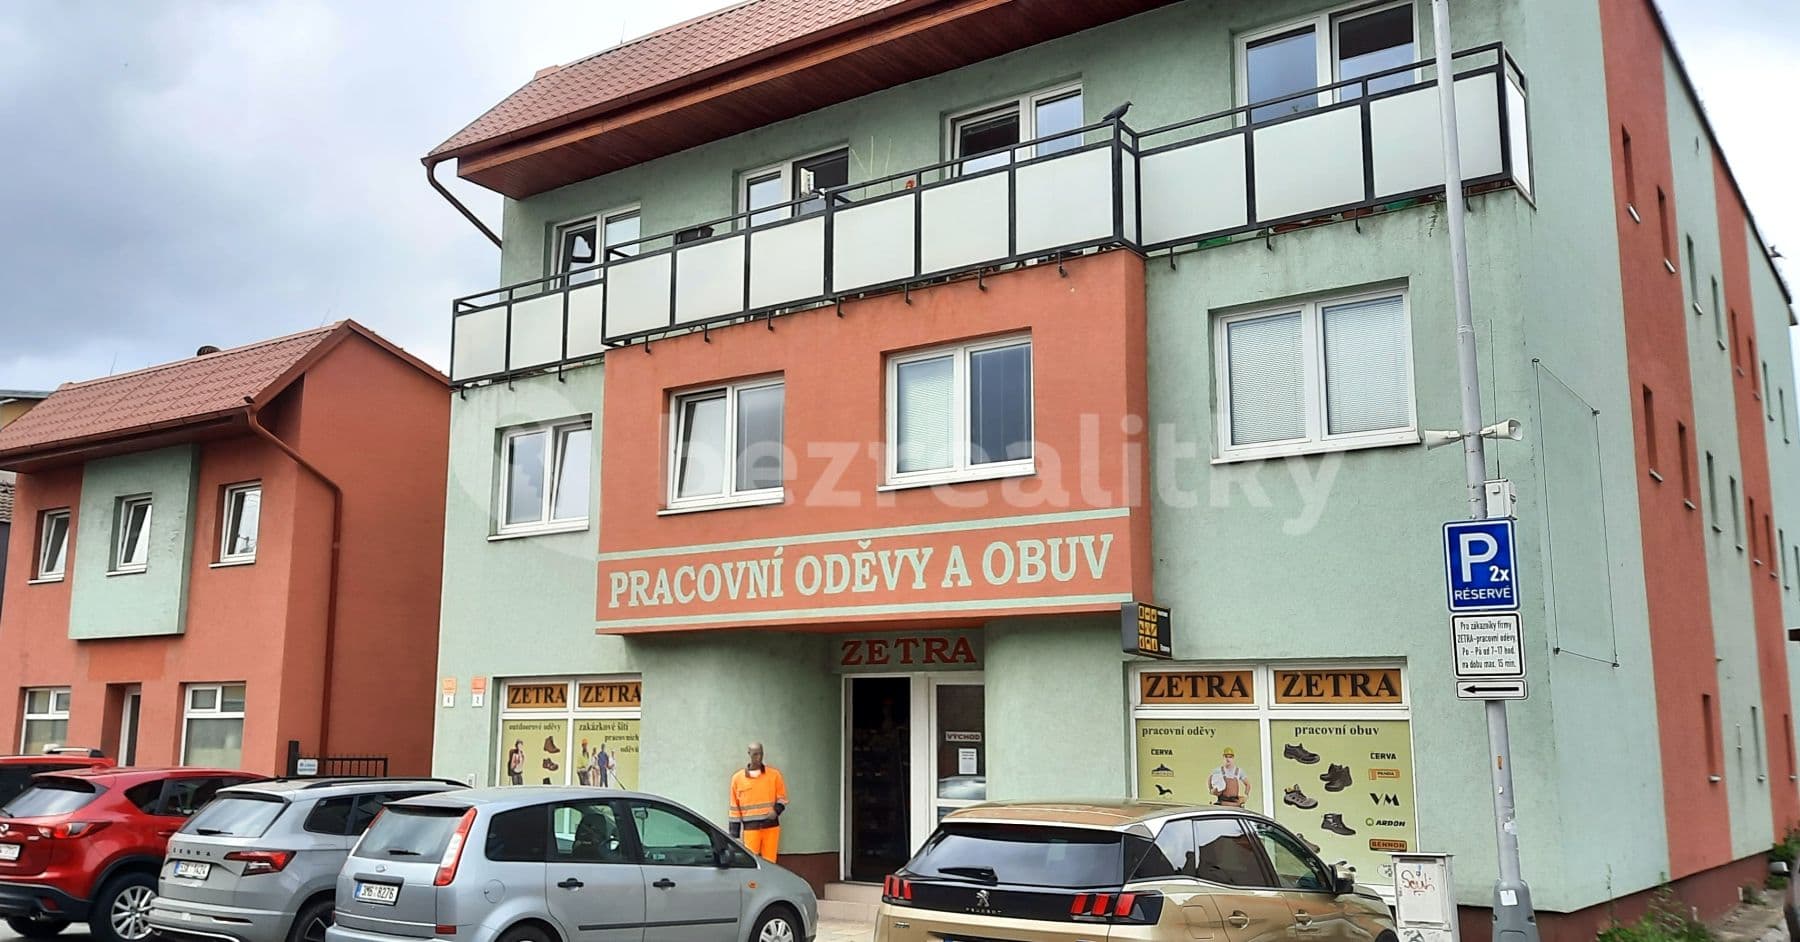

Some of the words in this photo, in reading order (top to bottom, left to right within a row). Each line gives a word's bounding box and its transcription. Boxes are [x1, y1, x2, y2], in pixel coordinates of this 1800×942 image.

[1459, 533, 1498, 583] P
[609, 546, 785, 609] PRACOVNÍ
[795, 540, 934, 597] ODĚVY
[940, 549, 973, 589] A
[982, 533, 1115, 587] OBUV
[1490, 566, 1510, 582] 2x
[1455, 587, 1512, 601] RÉSERVÉ
[1460, 621, 1470, 630] Pro
[841, 637, 977, 666] ZETRA
[1470, 658, 1483, 669] dobu
[1145, 673, 1249, 699] ZETRA
[1282, 673, 1399, 700] ZETRA
[510, 687, 567, 705] ZETRA
[582, 685, 642, 703] ZETRA
[579, 722, 615, 731] zakázkové
[1141, 726, 1184, 737] pracovní
[1186, 726, 1216, 738] oděvy
[1294, 726, 1347, 737] pracovní
[1349, 725, 1379, 736] obuv
[1370, 793, 1400, 806] VM
[1375, 819, 1406, 827] ARDON
[1371, 840, 1406, 849] BENNON
